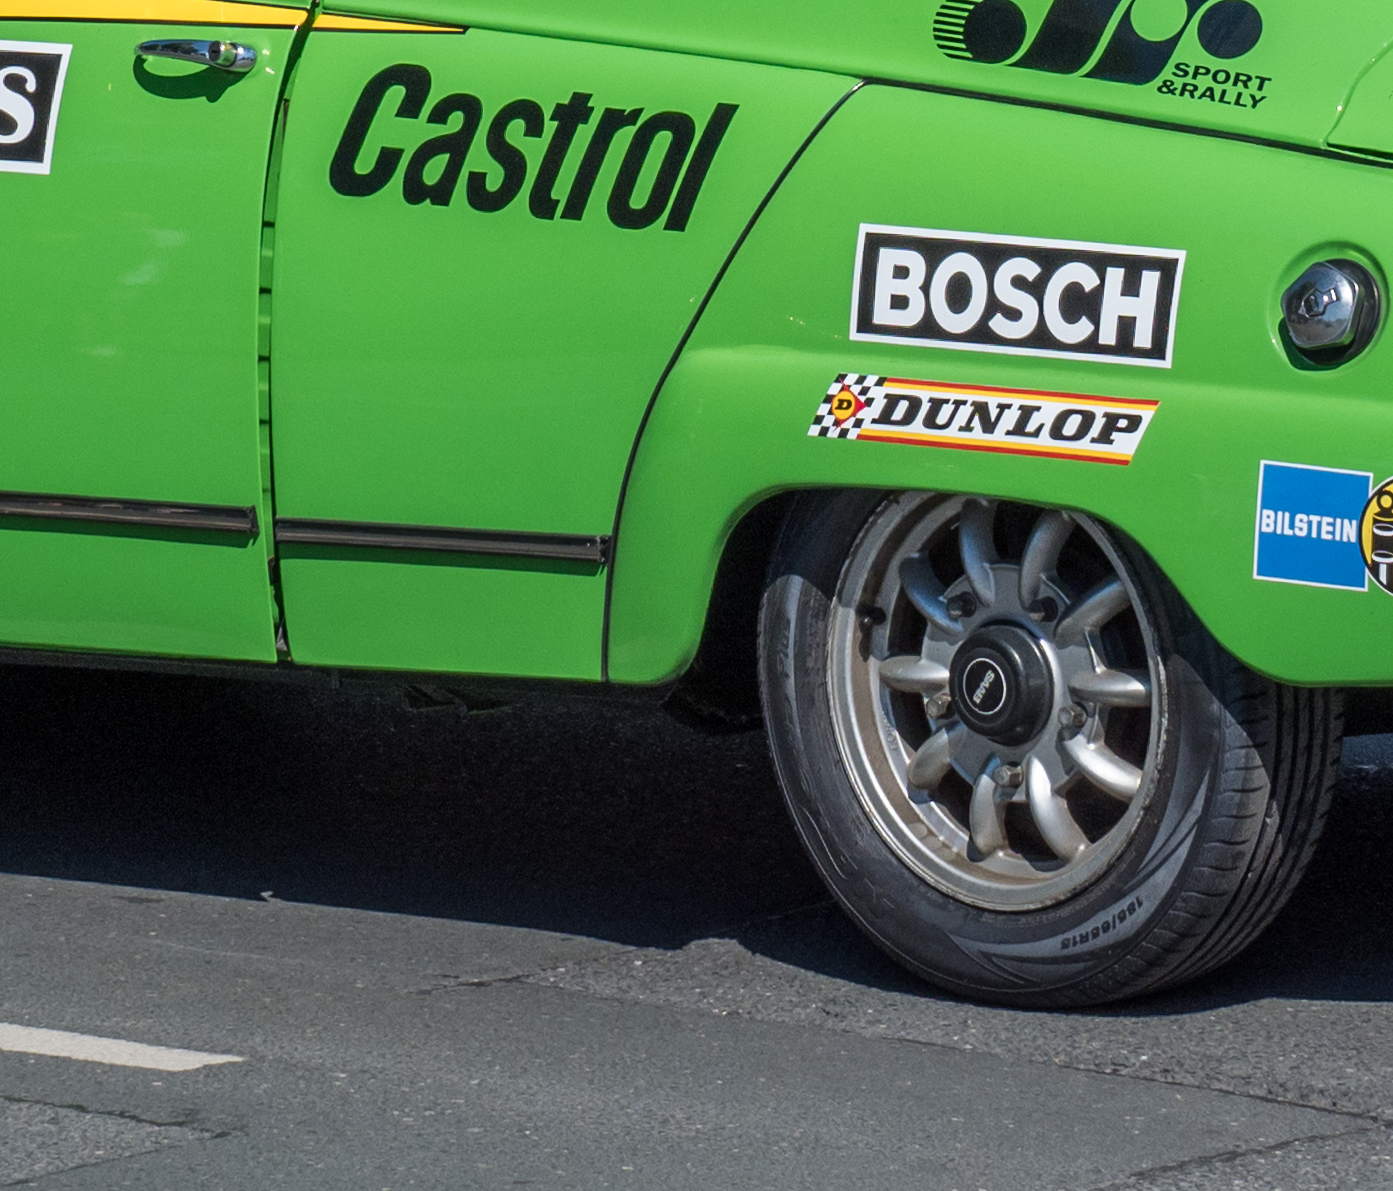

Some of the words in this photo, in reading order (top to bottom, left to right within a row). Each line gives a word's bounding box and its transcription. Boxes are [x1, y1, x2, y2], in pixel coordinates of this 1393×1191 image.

[1157, 79, 1268, 110] &RALLY
[1171, 62, 1273, 93] SPORT
[328, 62, 741, 233] Castrol
[871, 246, 1161, 350] BOSCH
[834, 398, 853, 411] D
[870, 392, 1144, 446] DUNLOP
[1260, 509, 1357, 544] BILSTEIN
